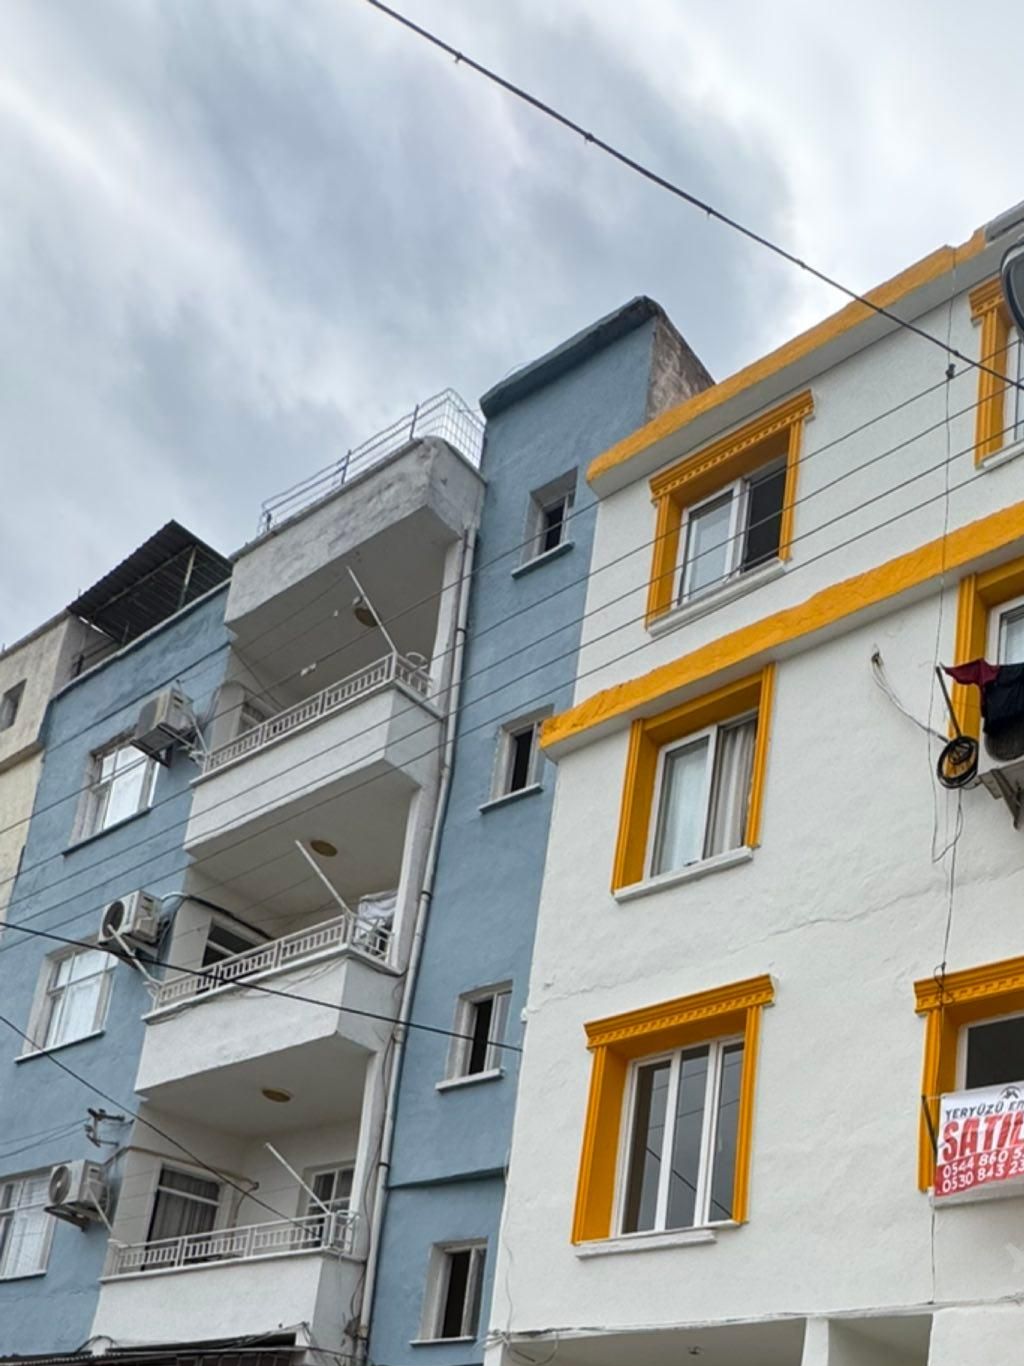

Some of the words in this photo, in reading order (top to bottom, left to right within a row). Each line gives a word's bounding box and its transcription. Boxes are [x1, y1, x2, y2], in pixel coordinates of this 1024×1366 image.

[945, 1101, 1005, 1121] YERYÜZÜ
[942, 1156, 975, 1179] 0544
[979, 1150, 1009, 1167] 860
[942, 1171, 974, 1193] 0530
